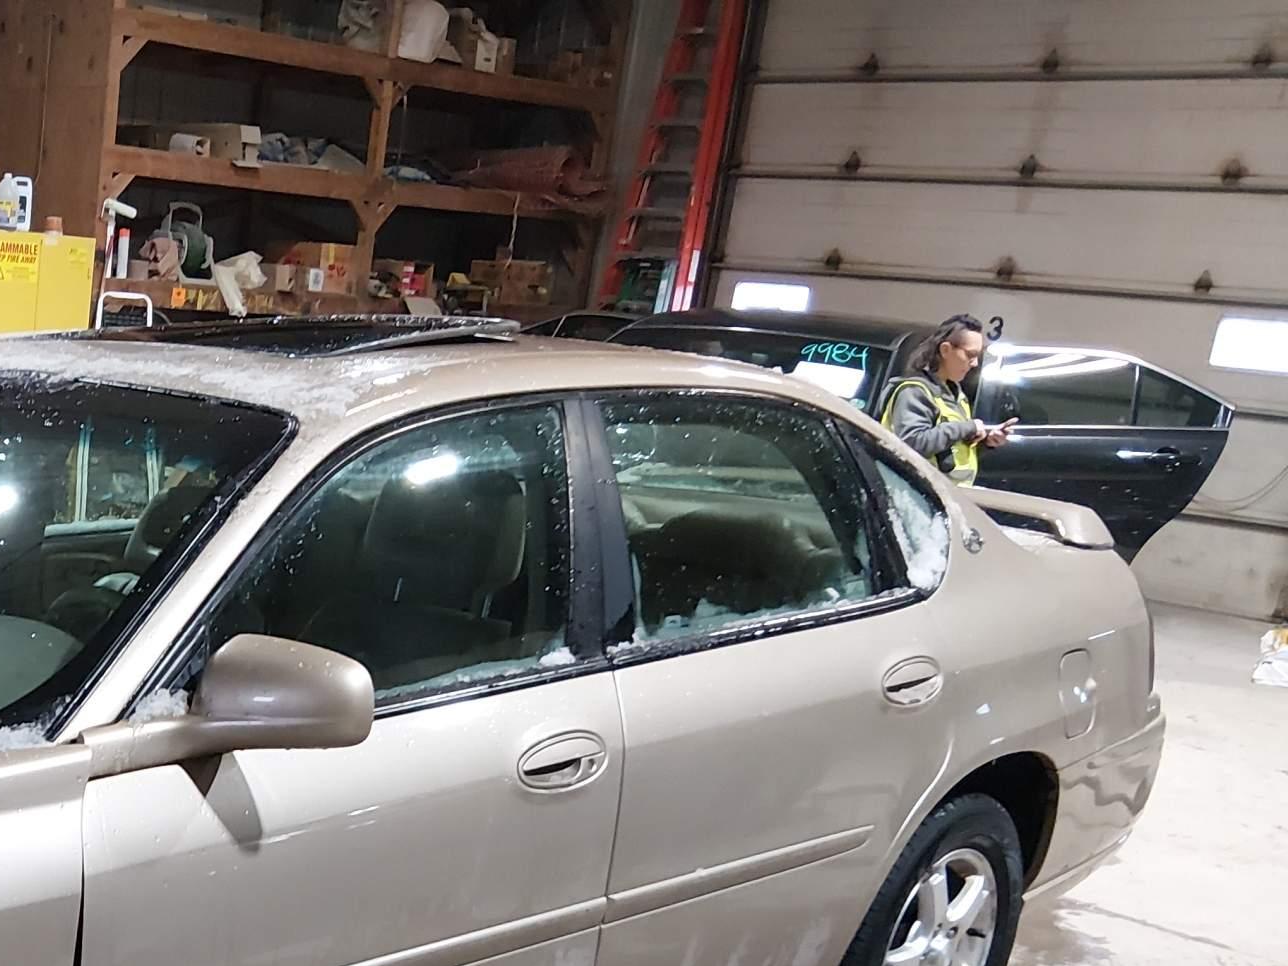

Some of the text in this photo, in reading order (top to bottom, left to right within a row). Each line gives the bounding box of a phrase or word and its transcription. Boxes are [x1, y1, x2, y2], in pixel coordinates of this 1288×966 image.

[6, 254, 20, 263] FIRE
[20, 255, 37, 265] AWAY
[986, 316, 1004, 341] 3
[800, 342, 870, 370] 9984
